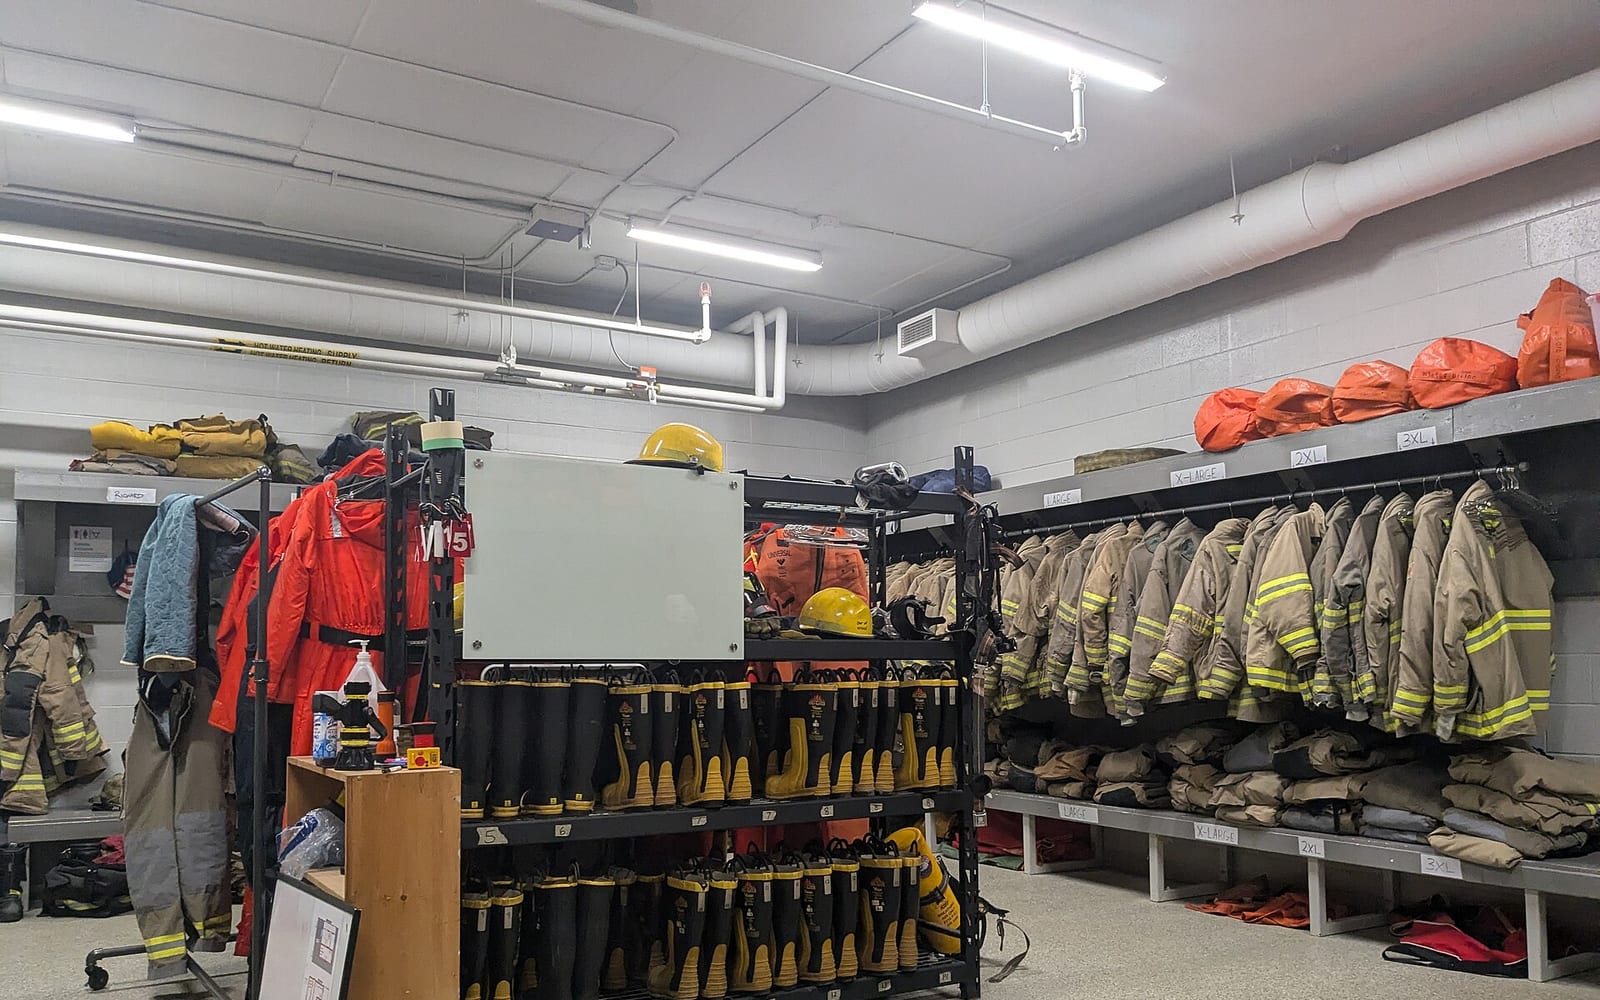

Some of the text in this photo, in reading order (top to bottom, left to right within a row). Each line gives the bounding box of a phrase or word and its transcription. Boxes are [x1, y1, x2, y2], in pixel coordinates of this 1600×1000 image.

[327, 350, 358, 360] SUPPLY
[1402, 431, 1428, 448] 3XL
[1295, 449, 1322, 466] 2XL
[1174, 467, 1217, 485] X-LARGE
[1047, 492, 1072, 507] LARGE
[452, 531, 468, 552] 5
[483, 829, 496, 844] 5
[559, 826, 567, 836] 6
[1196, 824, 1236, 843] X-LARGE
[1301, 840, 1321, 855] 2XL
[1425, 857, 1456, 874] 3XL
